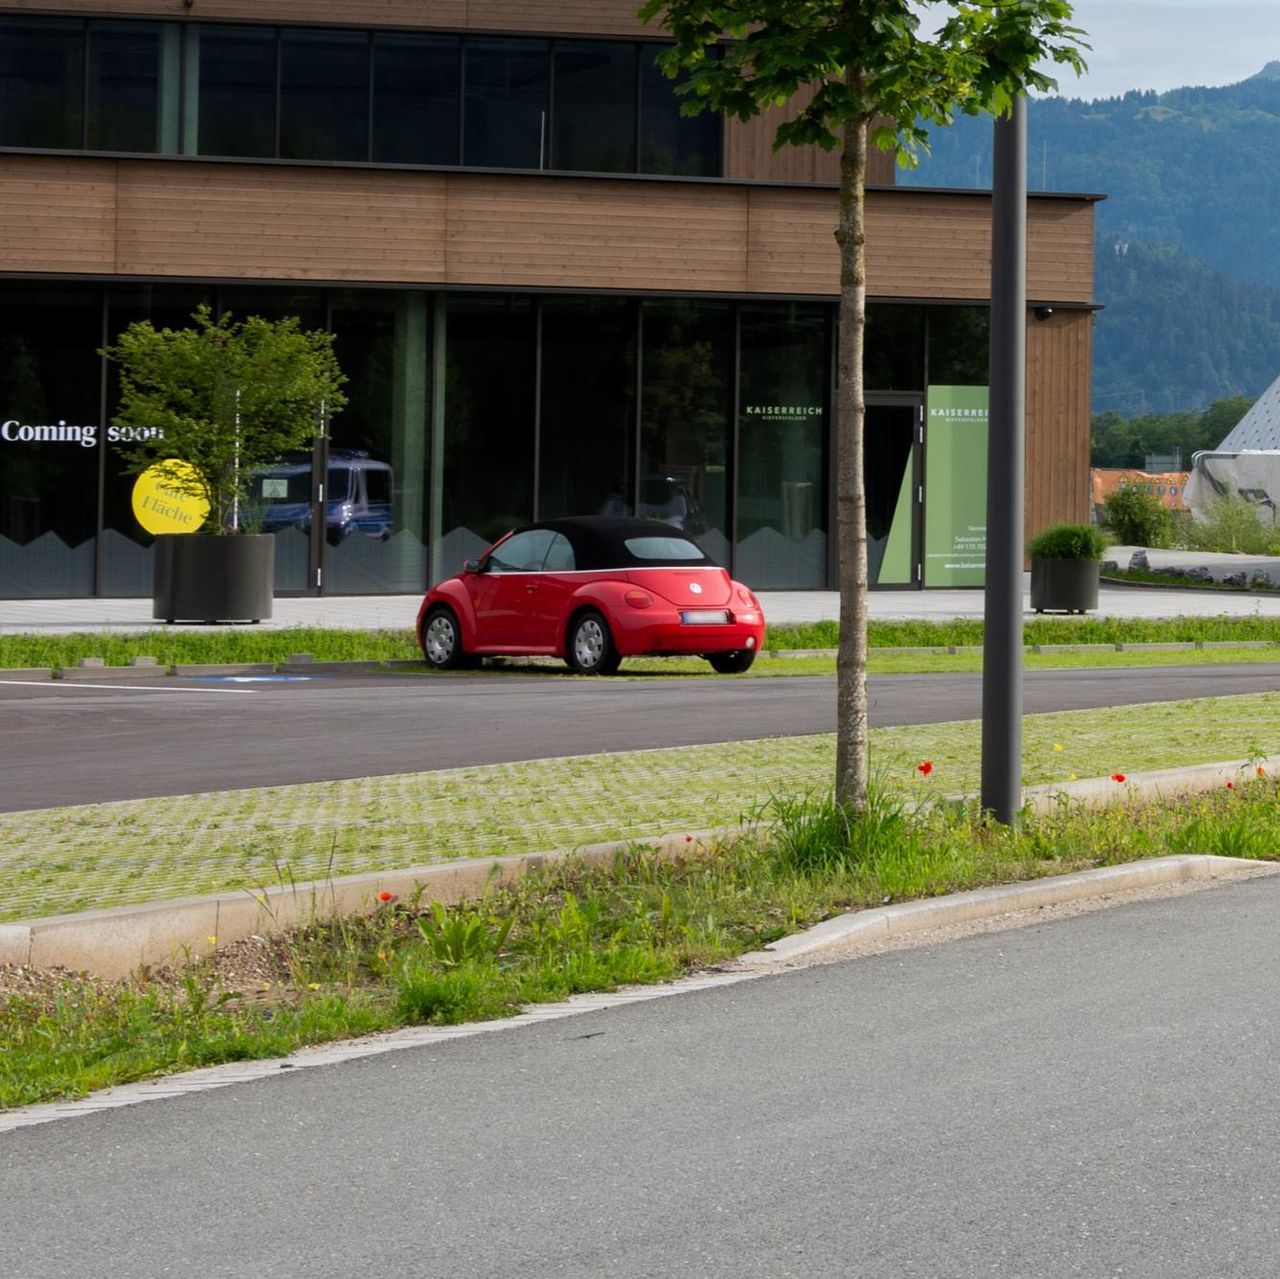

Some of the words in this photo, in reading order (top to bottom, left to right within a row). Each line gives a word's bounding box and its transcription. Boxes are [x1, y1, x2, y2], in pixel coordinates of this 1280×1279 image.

[746, 405, 823, 415] KAISERREICH
[930, 408, 989, 417] KAISERREI
[1, 420, 98, 448] Coming
[142, 495, 193, 525] Fläche
